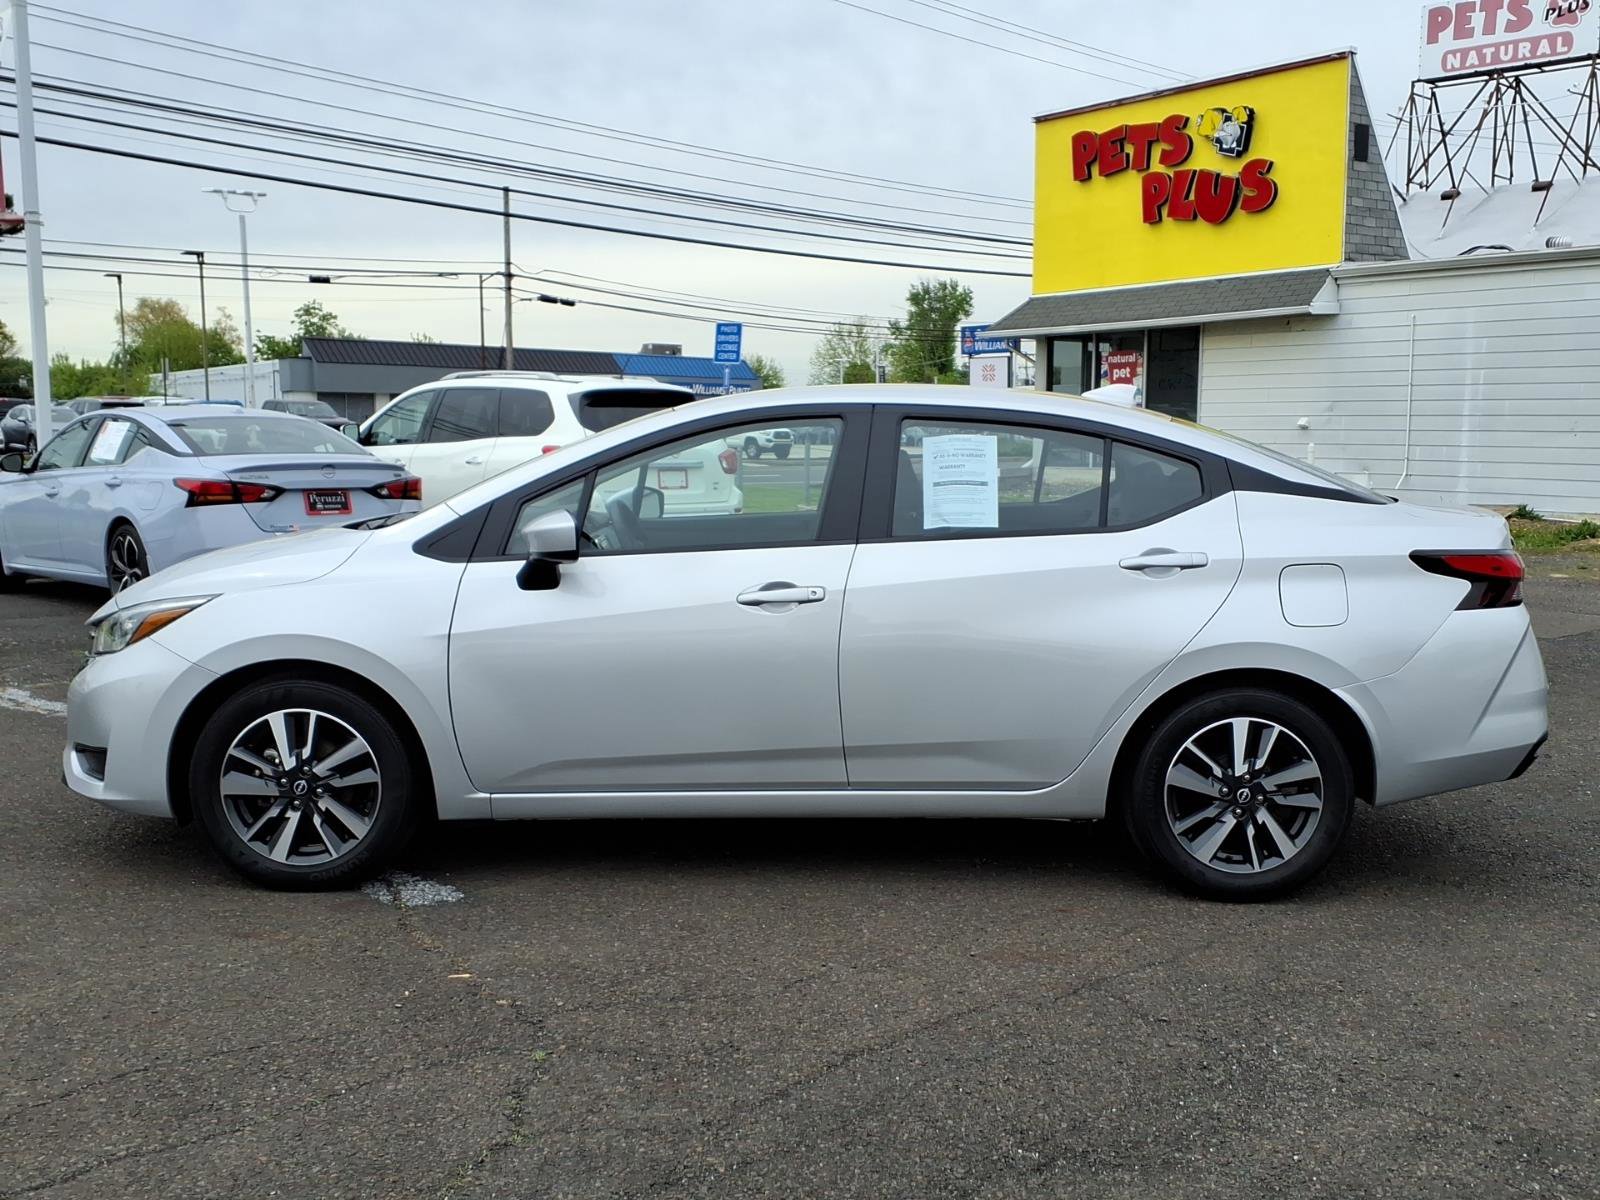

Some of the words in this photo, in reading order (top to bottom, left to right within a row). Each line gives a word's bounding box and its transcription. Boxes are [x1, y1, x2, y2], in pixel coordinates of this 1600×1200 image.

[1427, 0, 1533, 45] PETS
[1544, 0, 1590, 21] PLUS
[1446, 36, 1568, 70] NATURAL
[1071, 114, 1193, 182] PETS
[1142, 158, 1278, 225] PLUS
[1107, 352, 1136, 363] natural
[1112, 366, 1131, 381] pet
[309, 493, 345, 503] Peruzzi
